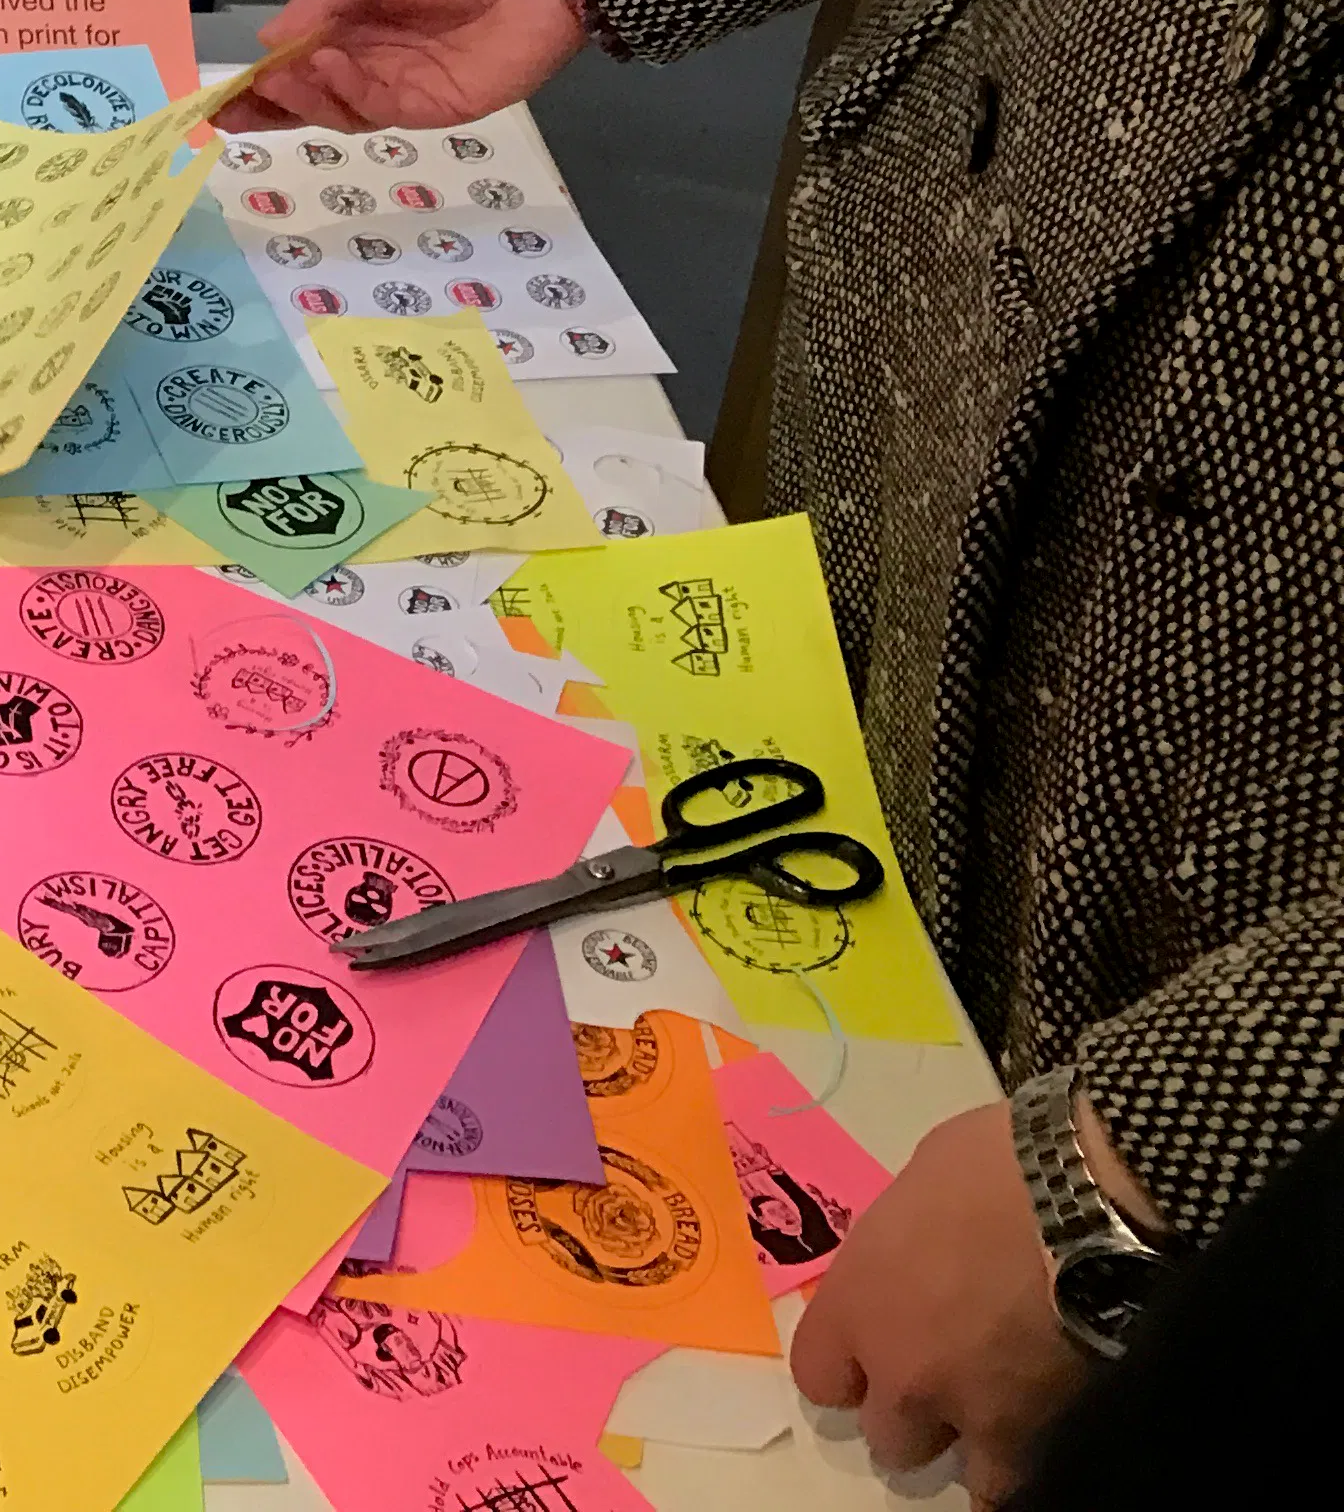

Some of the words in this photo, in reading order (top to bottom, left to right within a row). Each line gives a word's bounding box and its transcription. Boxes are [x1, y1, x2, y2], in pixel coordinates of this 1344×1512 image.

[17, 23, 78, 50] print
[85, 23, 121, 46] for
[26, 74, 131, 113] DECOLONIZE
[186, 279, 231, 320] DUTY
[133, 314, 167, 335] TO
[169, 318, 222, 340] WIN
[168, 368, 265, 402] CREATE
[164, 402, 284, 443] DANGEROUSLY
[240, 485, 280, 516] NO
[267, 490, 341, 535] FOR
[35, 571, 162, 645] DANGEROUSLY
[28, 606, 136, 662] CREATE
[46, 699, 82, 734] TO
[16, 748, 44, 770] IS
[42, 733, 73, 761] IT
[137, 755, 217, 784] FREE
[115, 778, 180, 857] ANGRY
[214, 781, 257, 828] GET
[189, 828, 244, 862] GET
[42, 874, 171, 973] CAPITALISM
[22, 918, 84, 981] BURY
[260, 984, 350, 1050] FOR
[271, 1026, 333, 1069] NO
[12, 1096, 51, 1118] Schools
[94, 1121, 155, 1167] Housing
[131, 1156, 149, 1172] is
[180, 1203, 233, 1244] Human
[229, 1166, 263, 1202] right
[661, 1191, 699, 1260] BREAD
[54, 1304, 117, 1372] DISBAND
[56, 1299, 142, 1396] DISEMPOWER
[485, 1442, 585, 1475] Accountable
